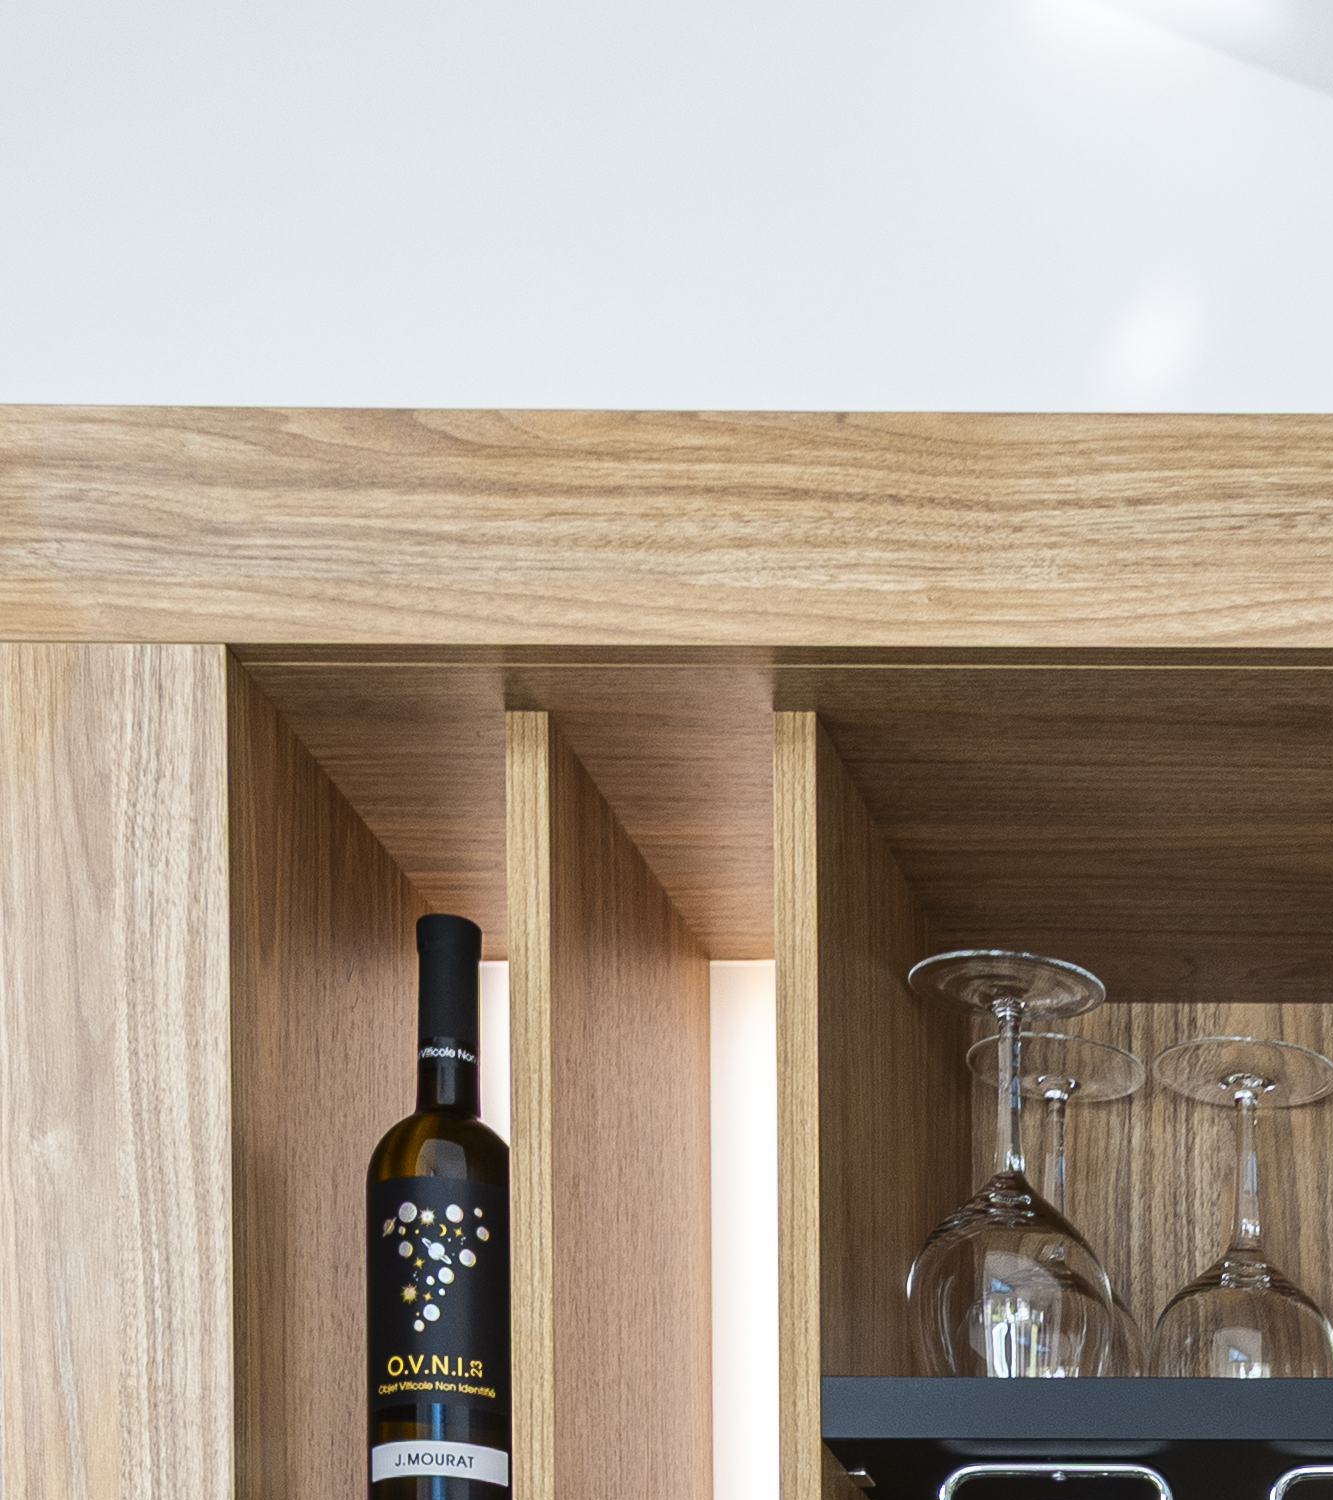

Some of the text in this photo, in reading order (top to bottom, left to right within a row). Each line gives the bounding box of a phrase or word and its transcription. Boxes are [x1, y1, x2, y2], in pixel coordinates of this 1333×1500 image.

[387, 1354, 483, 1378] O.V.N.I. 23
[435, 1381, 457, 1393] Non
[395, 1452, 475, 1469] J.MOURAT
